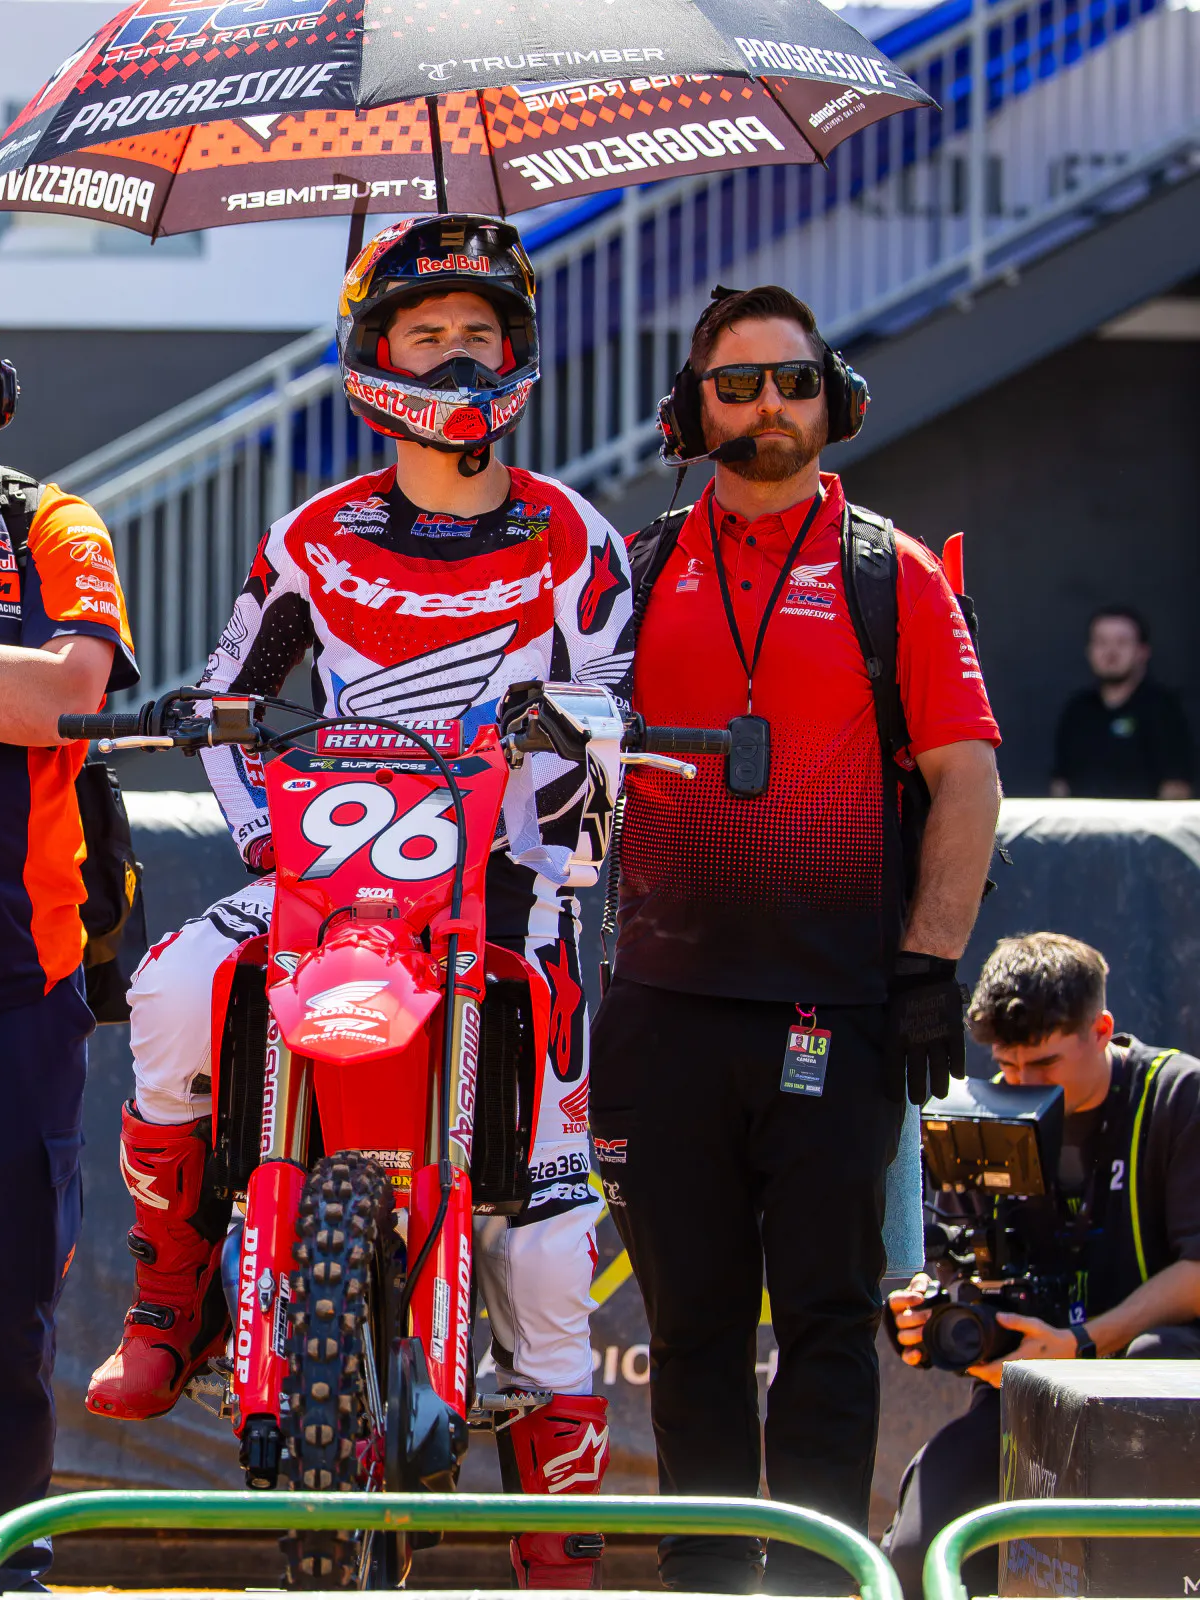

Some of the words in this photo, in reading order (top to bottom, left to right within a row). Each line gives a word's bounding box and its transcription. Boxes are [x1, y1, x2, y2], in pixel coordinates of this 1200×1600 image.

[102, 37, 207, 66] Honda
[211, 16, 320, 45] RACING
[463, 47, 666, 74] TRUETIMBER
[735, 36, 896, 89] PROGRESSIVE
[57, 62, 348, 145] PROGRESSIVE
[416, 254, 455, 274] Red
[455, 254, 491, 274] Bull
[789, 580, 836, 590] HONDA
[779, 607, 837, 621] PROGRESSIVE
[323, 733, 454, 748] RENTHAL
[341, 760, 427, 770] SUPERCROSS
[288, 780, 312, 790] AMA
[297, 780, 472, 882] 96
[356, 887, 394, 899] SKDA
[303, 1006, 388, 1021] HONDA
[808, 1036, 827, 1056] L3
[562, 1123, 588, 1134] HON
[378, 1160, 412, 1169] ECTION
[531, 1152, 589, 1181] sta360
[1110, 1160, 1125, 1190] 2
[236, 1226, 259, 1384] DUNLOP
[454, 1233, 472, 1402] DUNLOP
